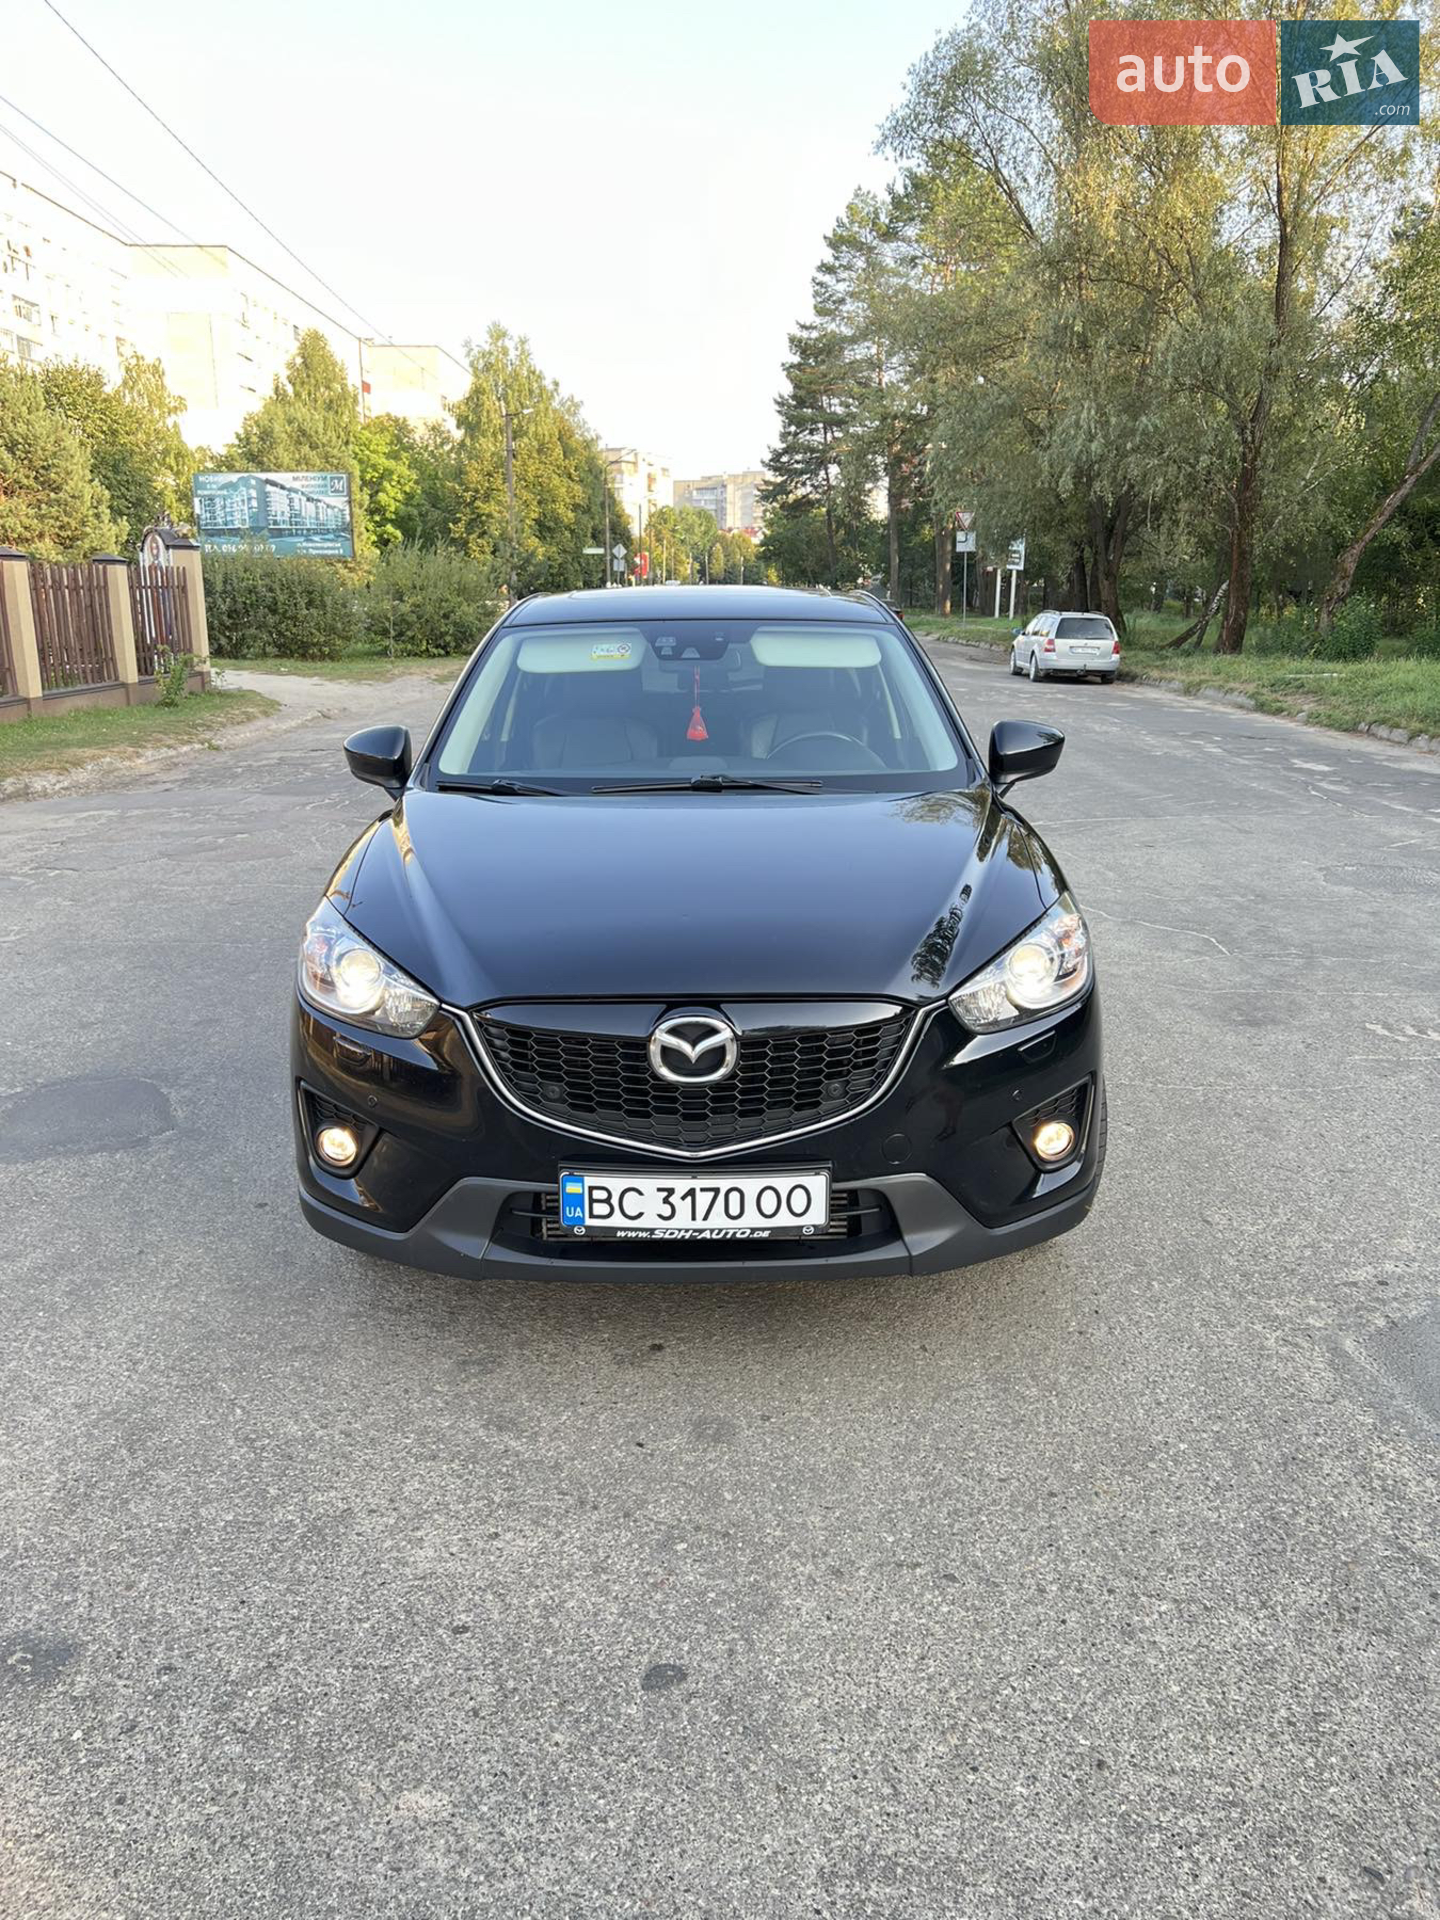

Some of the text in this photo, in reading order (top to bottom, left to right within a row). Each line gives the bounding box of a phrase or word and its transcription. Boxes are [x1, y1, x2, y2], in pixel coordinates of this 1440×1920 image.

[566, 1206, 583, 1218] UA
[588, 1184, 812, 1221] BC 3170 OO
